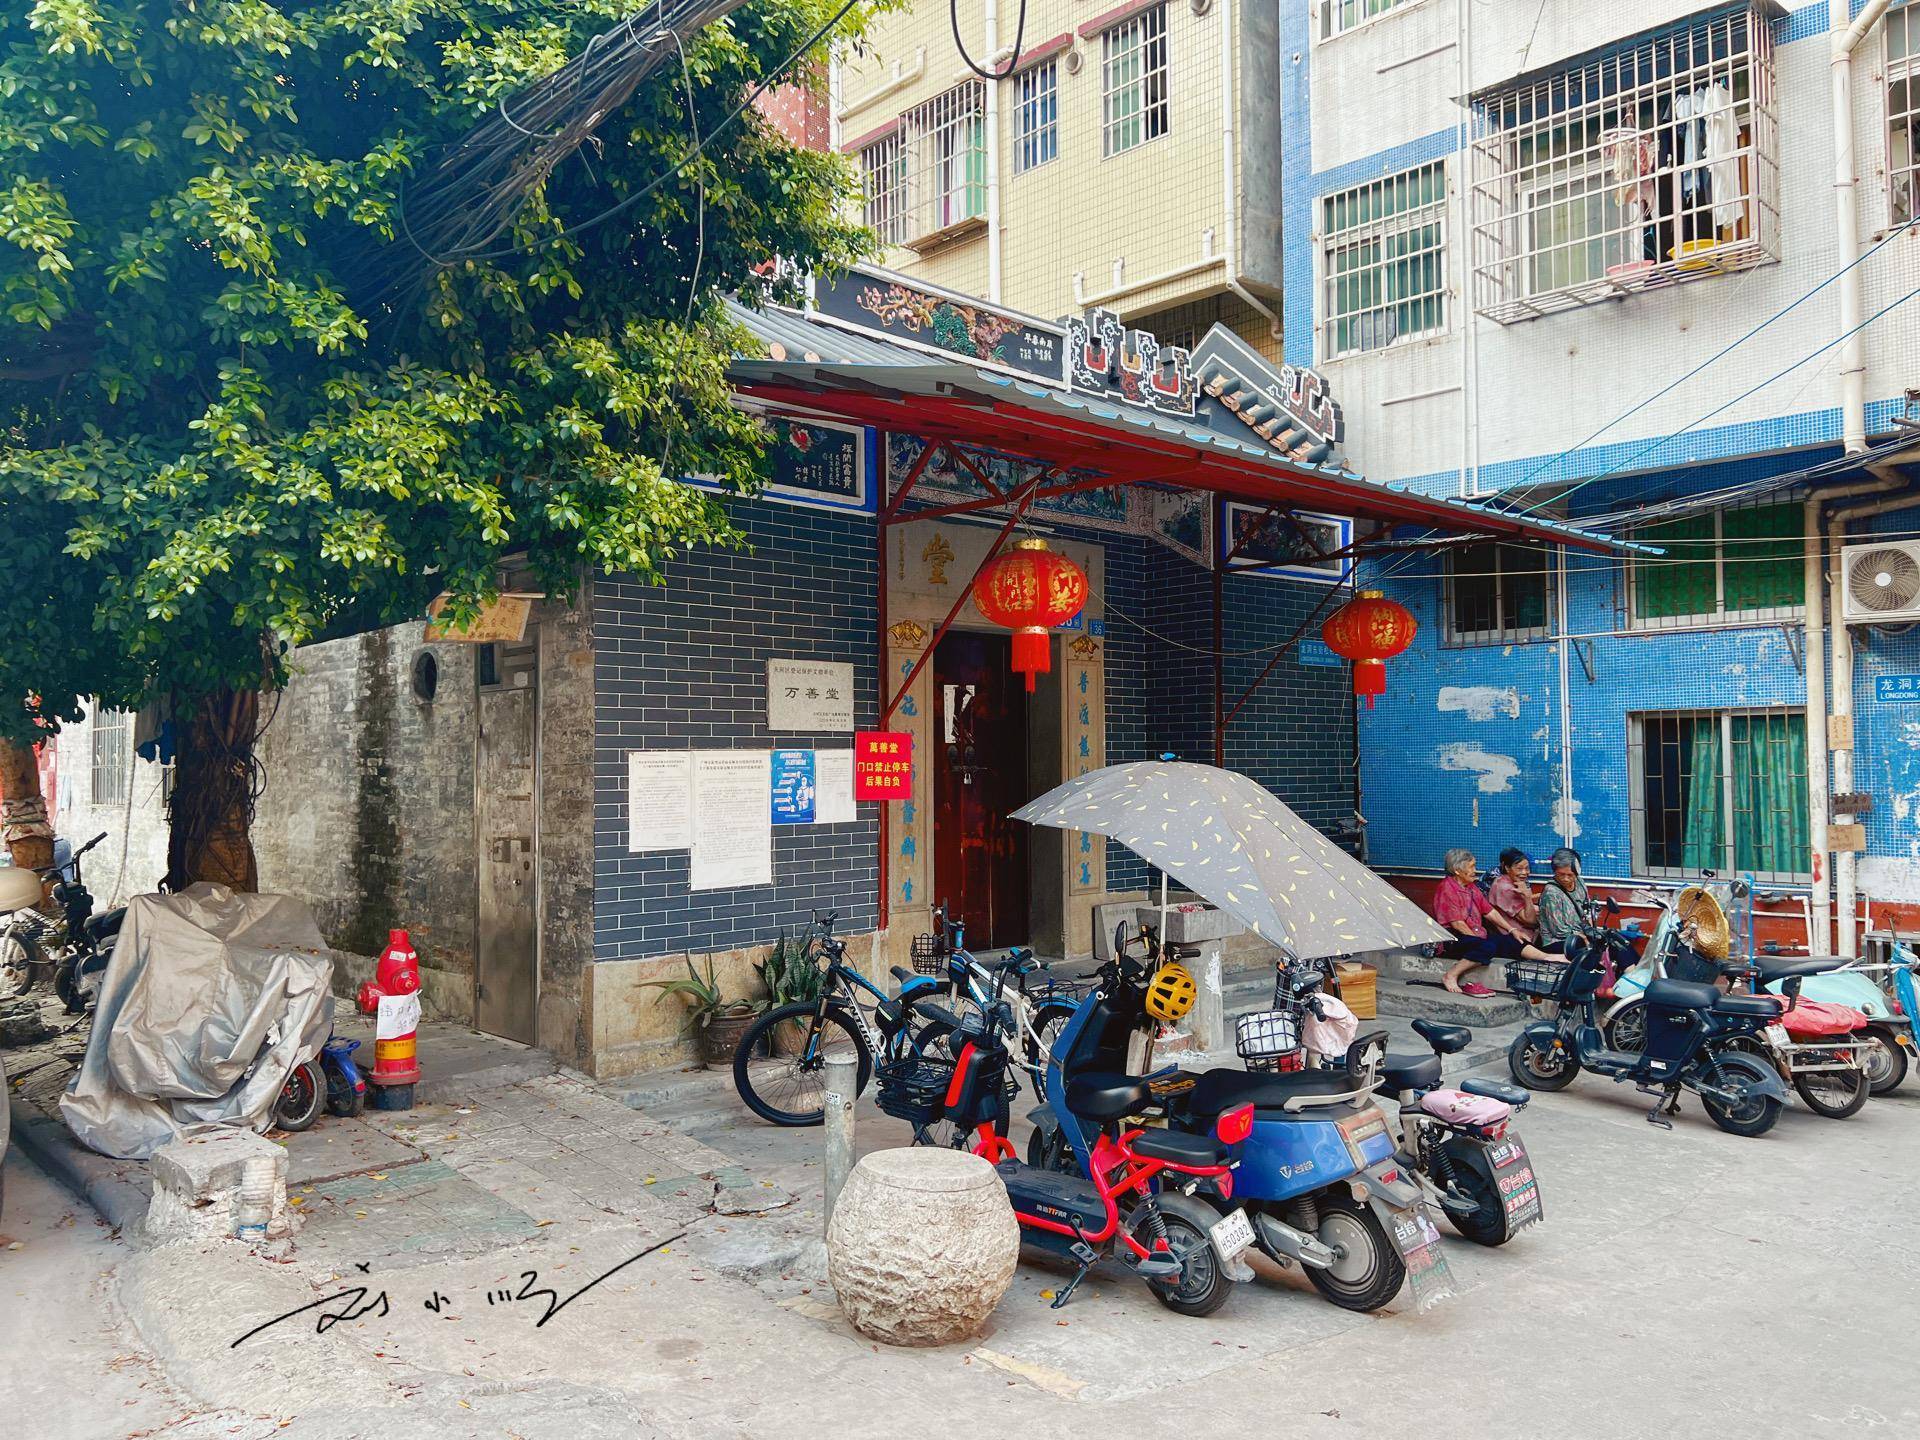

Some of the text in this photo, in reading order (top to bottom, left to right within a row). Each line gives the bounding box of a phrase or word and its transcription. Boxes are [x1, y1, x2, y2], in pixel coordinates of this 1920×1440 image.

[784, 687, 840, 700] 万善堂
[857, 761, 910, 773] 门口禁止停车
[865, 776, 901, 787] 后果自负
